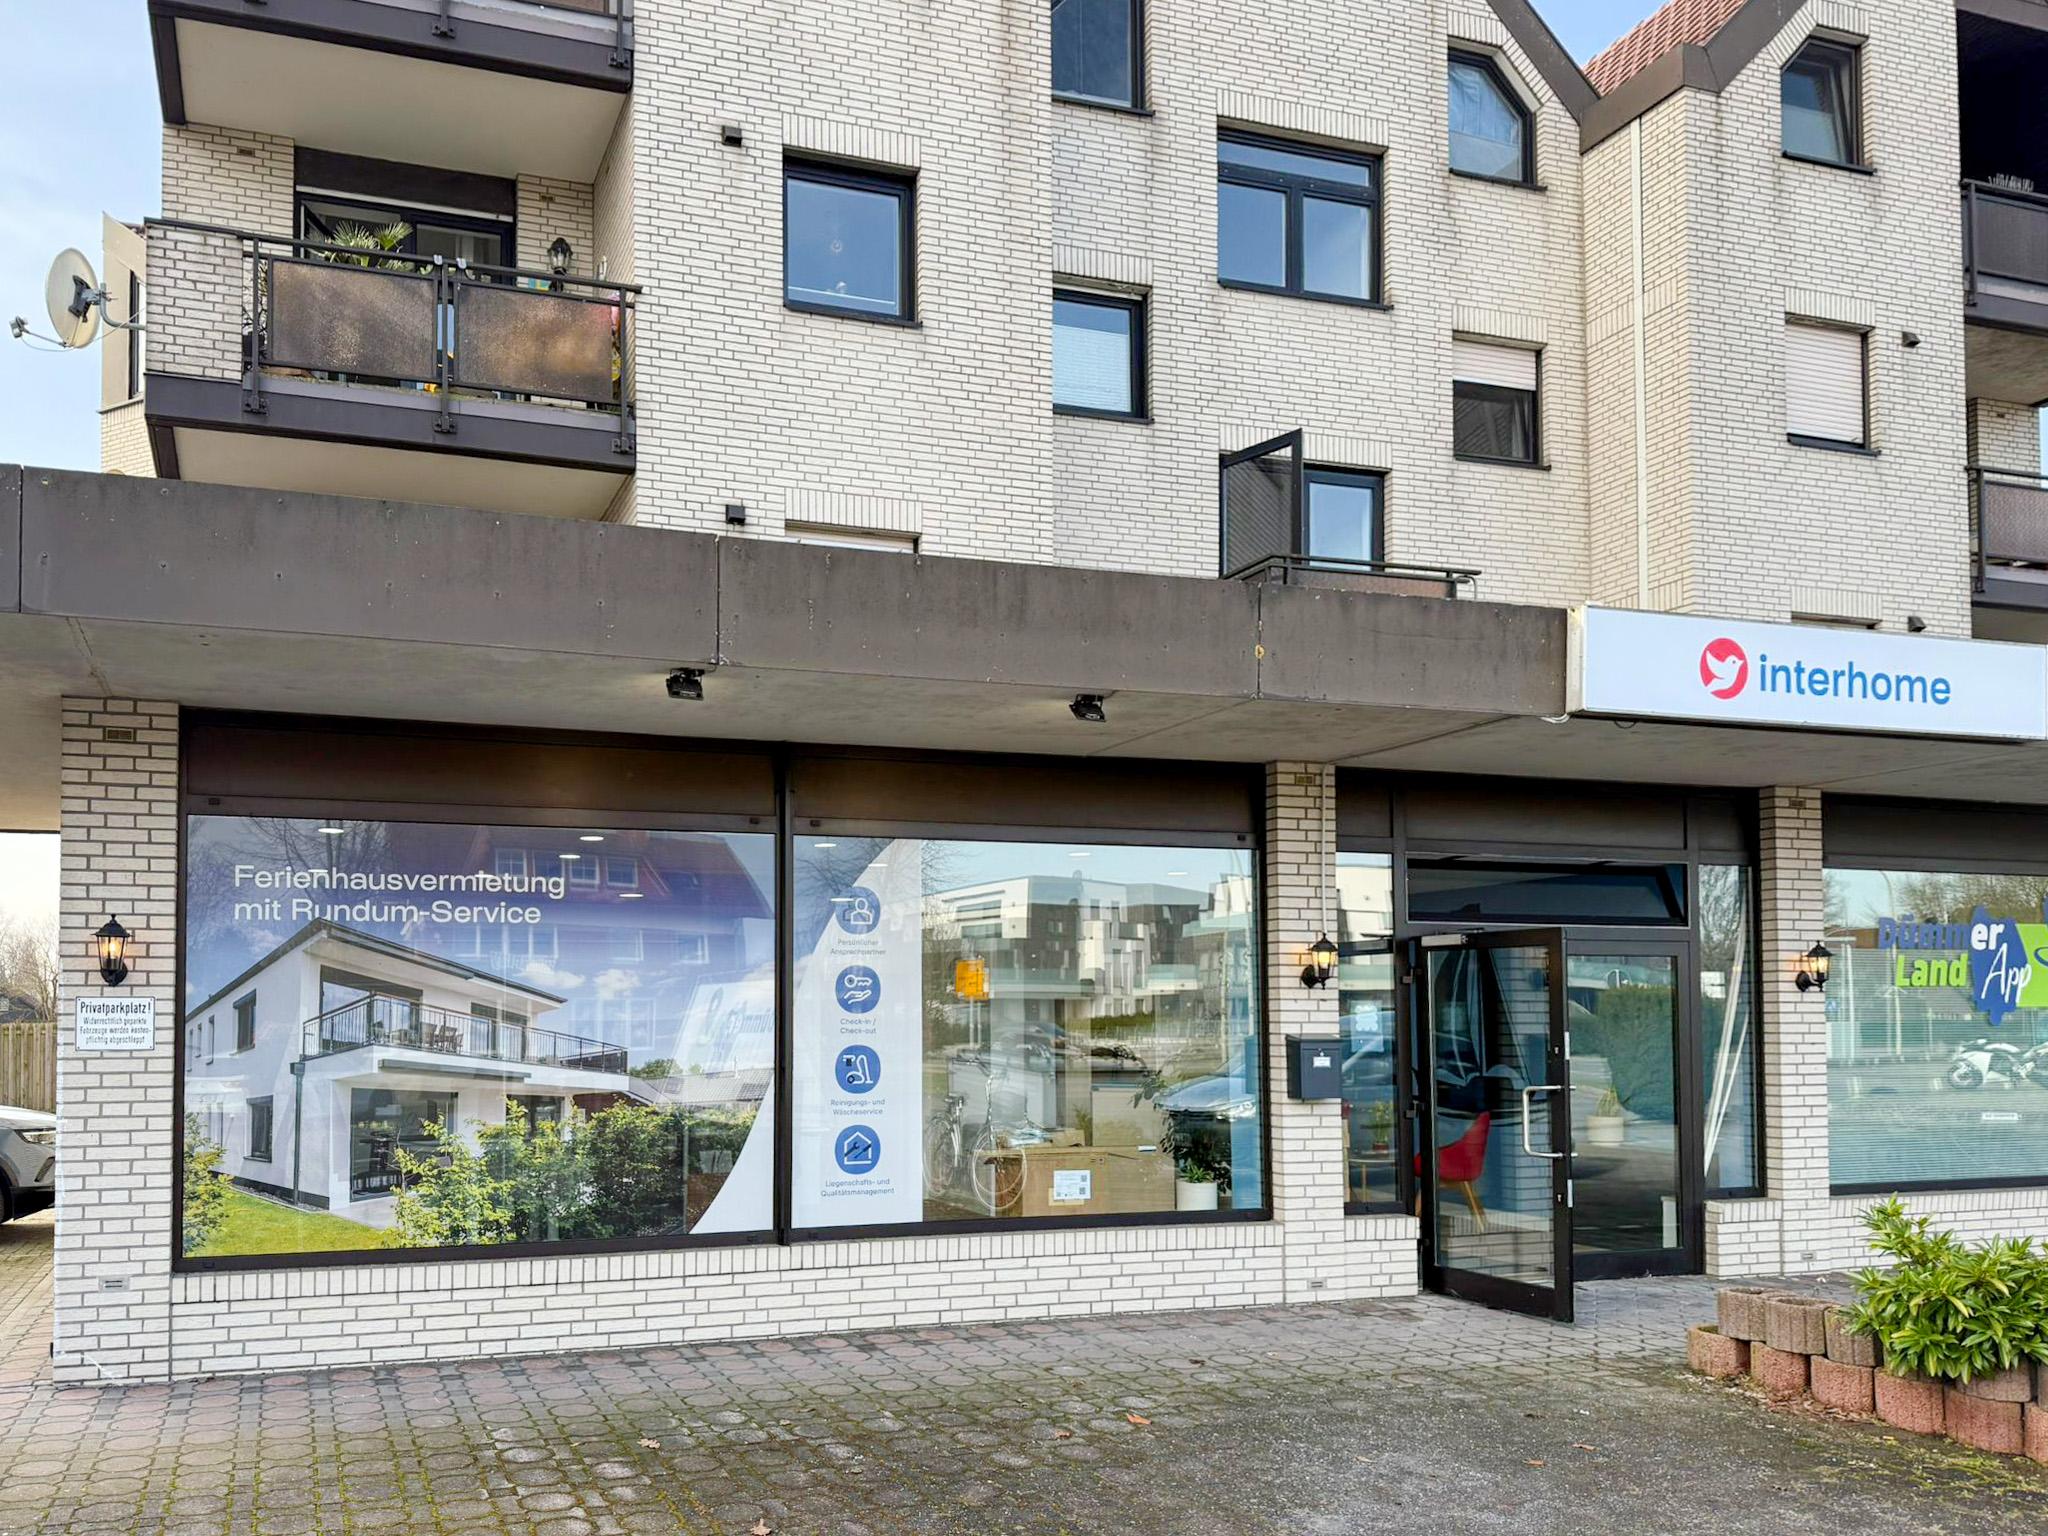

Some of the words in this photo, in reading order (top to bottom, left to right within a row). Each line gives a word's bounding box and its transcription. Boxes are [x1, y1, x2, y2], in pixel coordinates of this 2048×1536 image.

[1759, 653, 1951, 705] interhome
[233, 864, 565, 900] Ferienhausvermietung
[233, 898, 281, 922] mit
[291, 898, 542, 924] Rundum-Service
[1878, 912, 2005, 951] Dümmer
[1895, 953, 1969, 988] Land
[1980, 942, 2032, 1004] App
[840, 1018, 872, 1026] Check-in
[840, 1027, 877, 1035] Check-out
[830, 1099, 871, 1107] Reinigungs-
[832, 1108, 884, 1116] Wäscheservice
[820, 1187, 895, 1197] Qualitätsmanagement
[825, 1179, 875, 1188] Liegenschafts-
[876, 1178, 890, 1186] und
